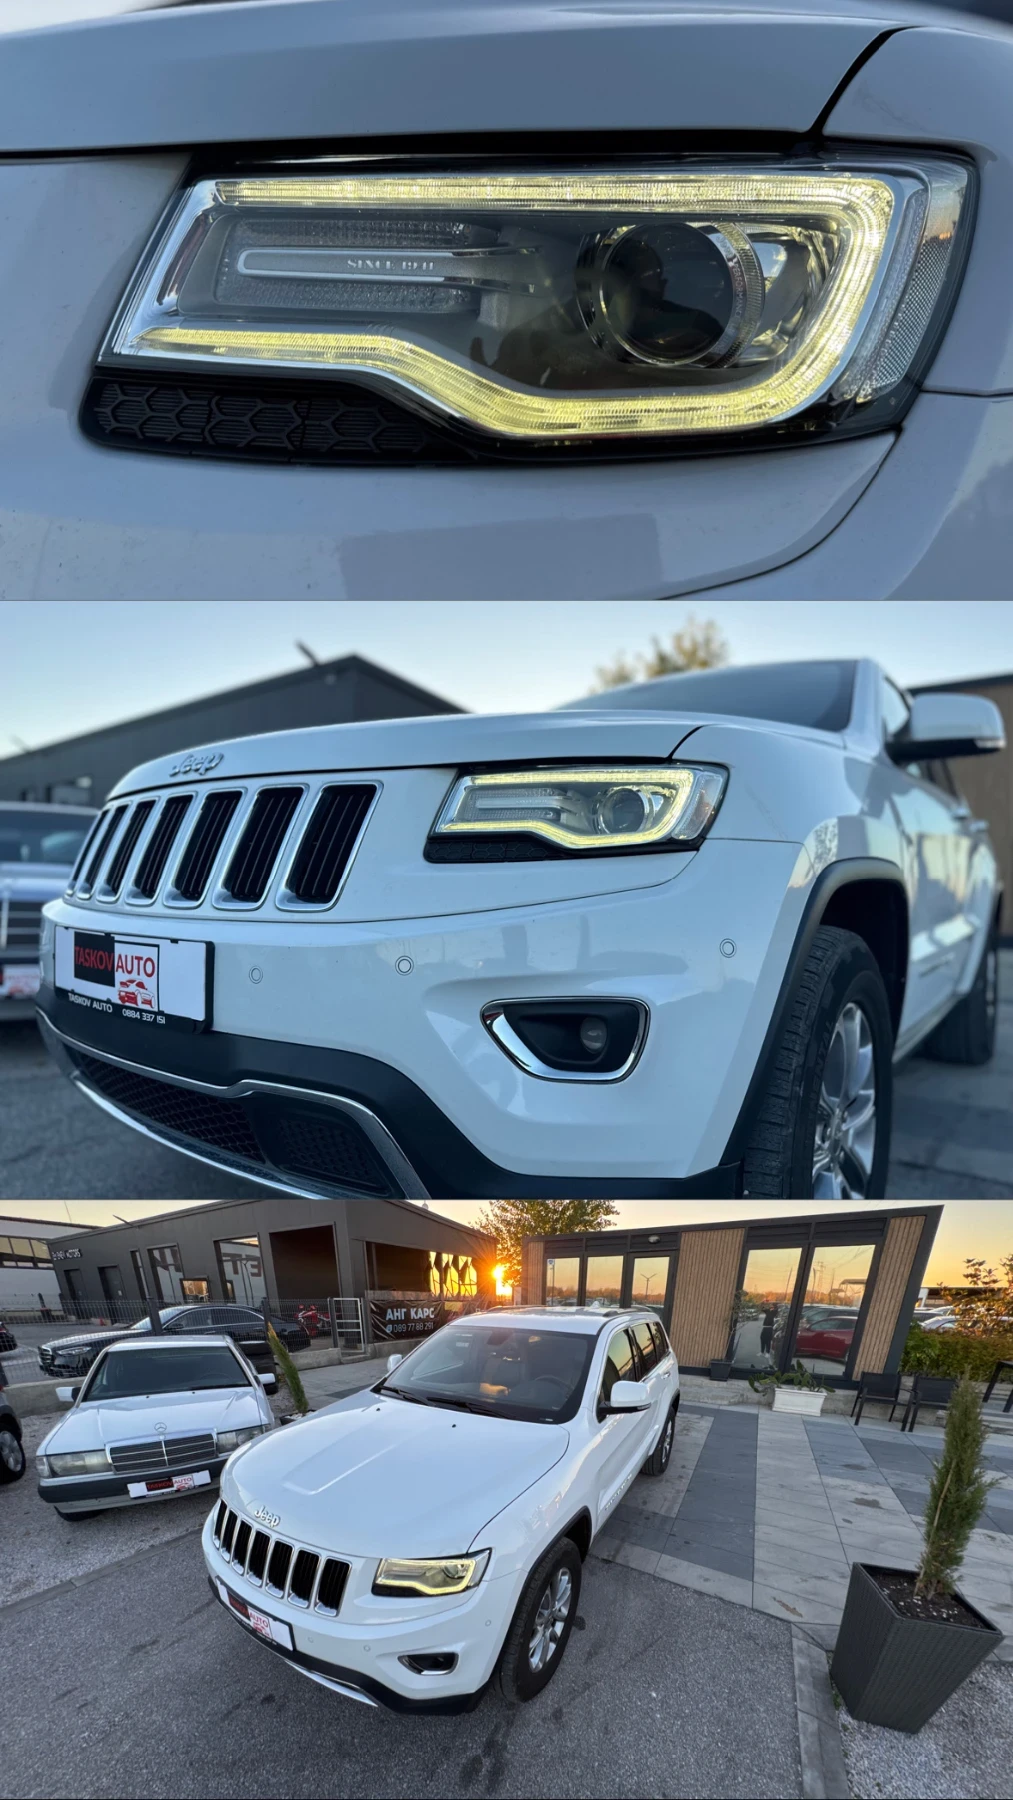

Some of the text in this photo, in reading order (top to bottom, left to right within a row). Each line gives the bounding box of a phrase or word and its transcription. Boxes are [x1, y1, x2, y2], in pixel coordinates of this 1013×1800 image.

[347, 259, 396, 270] SINCE
[169, 753, 224, 777] Jeep
[74, 946, 156, 978] TASKOV AUTO
[68, 992, 92, 1008] TASKOV
[92, 1001, 113, 1013] AUTO
[122, 1008, 141, 1020] 0884
[141, 1014, 155, 1023] 337
[385, 1307, 435, 1320] АНГ КАРС
[173, 1477, 193, 1485] AUTO
[254, 1506, 280, 1527] Jeep
[250, 1611, 269, 1628] AUTO
